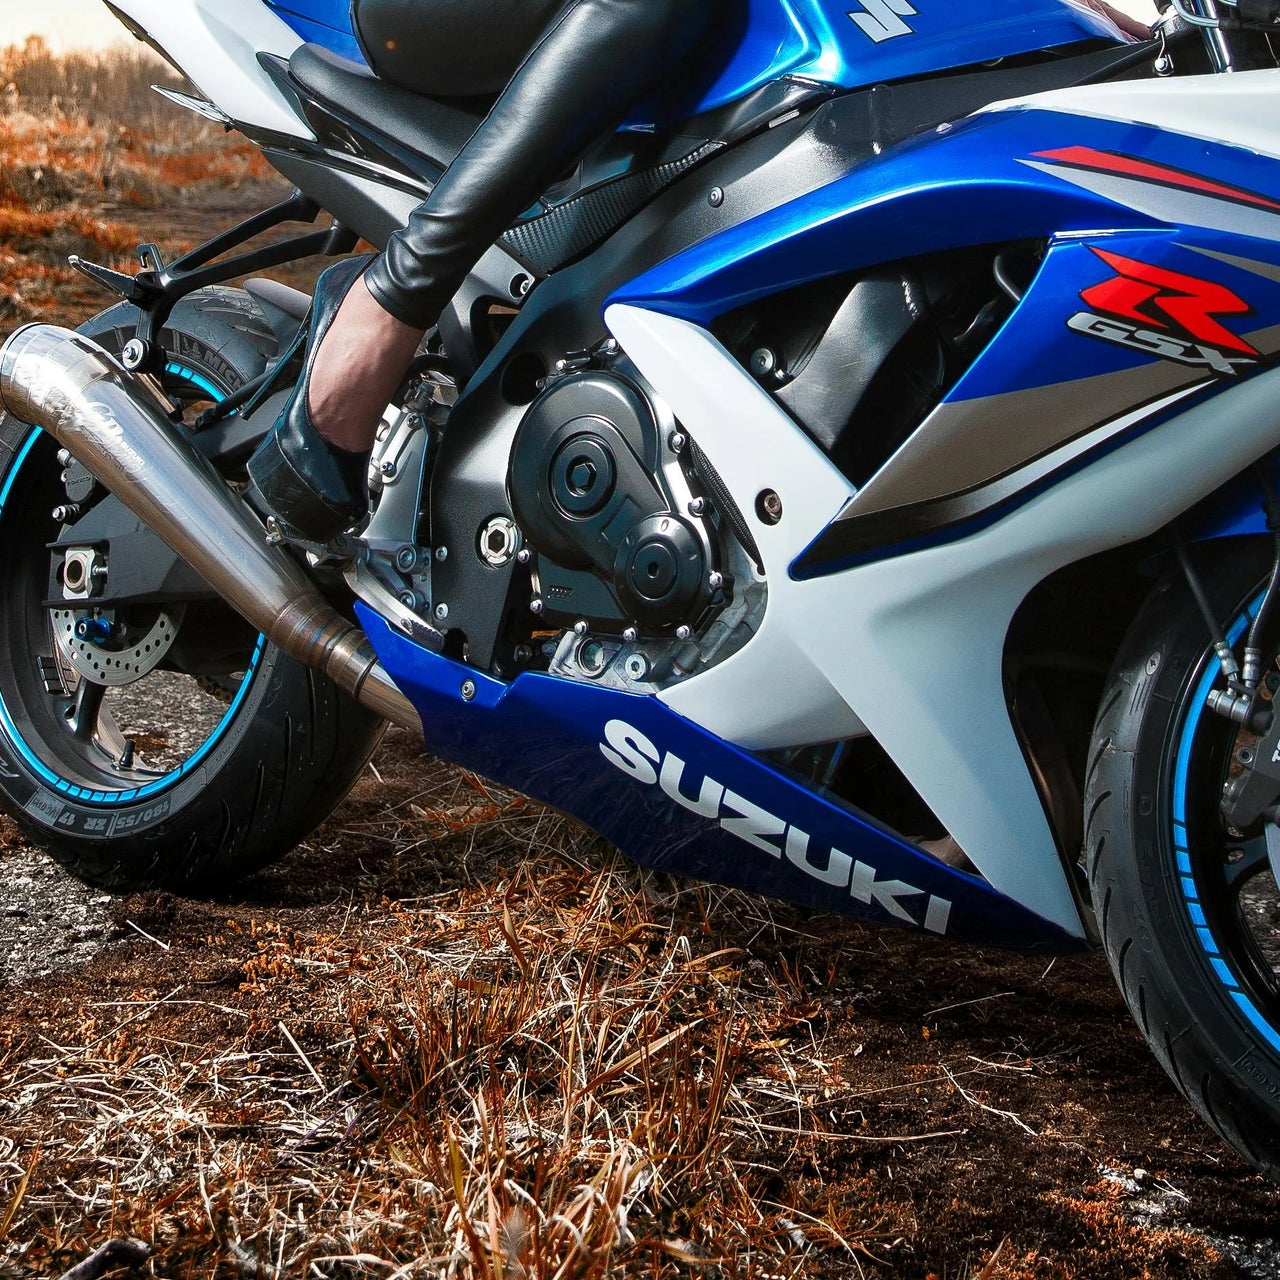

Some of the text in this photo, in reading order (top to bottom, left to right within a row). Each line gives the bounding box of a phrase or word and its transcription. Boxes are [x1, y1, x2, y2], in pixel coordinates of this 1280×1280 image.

[1066, 312, 1259, 375] GSX
[1080, 245, 1259, 356] R
[116, 800, 169, 829] 180/55
[599, 719, 951, 935] SUZUKI
